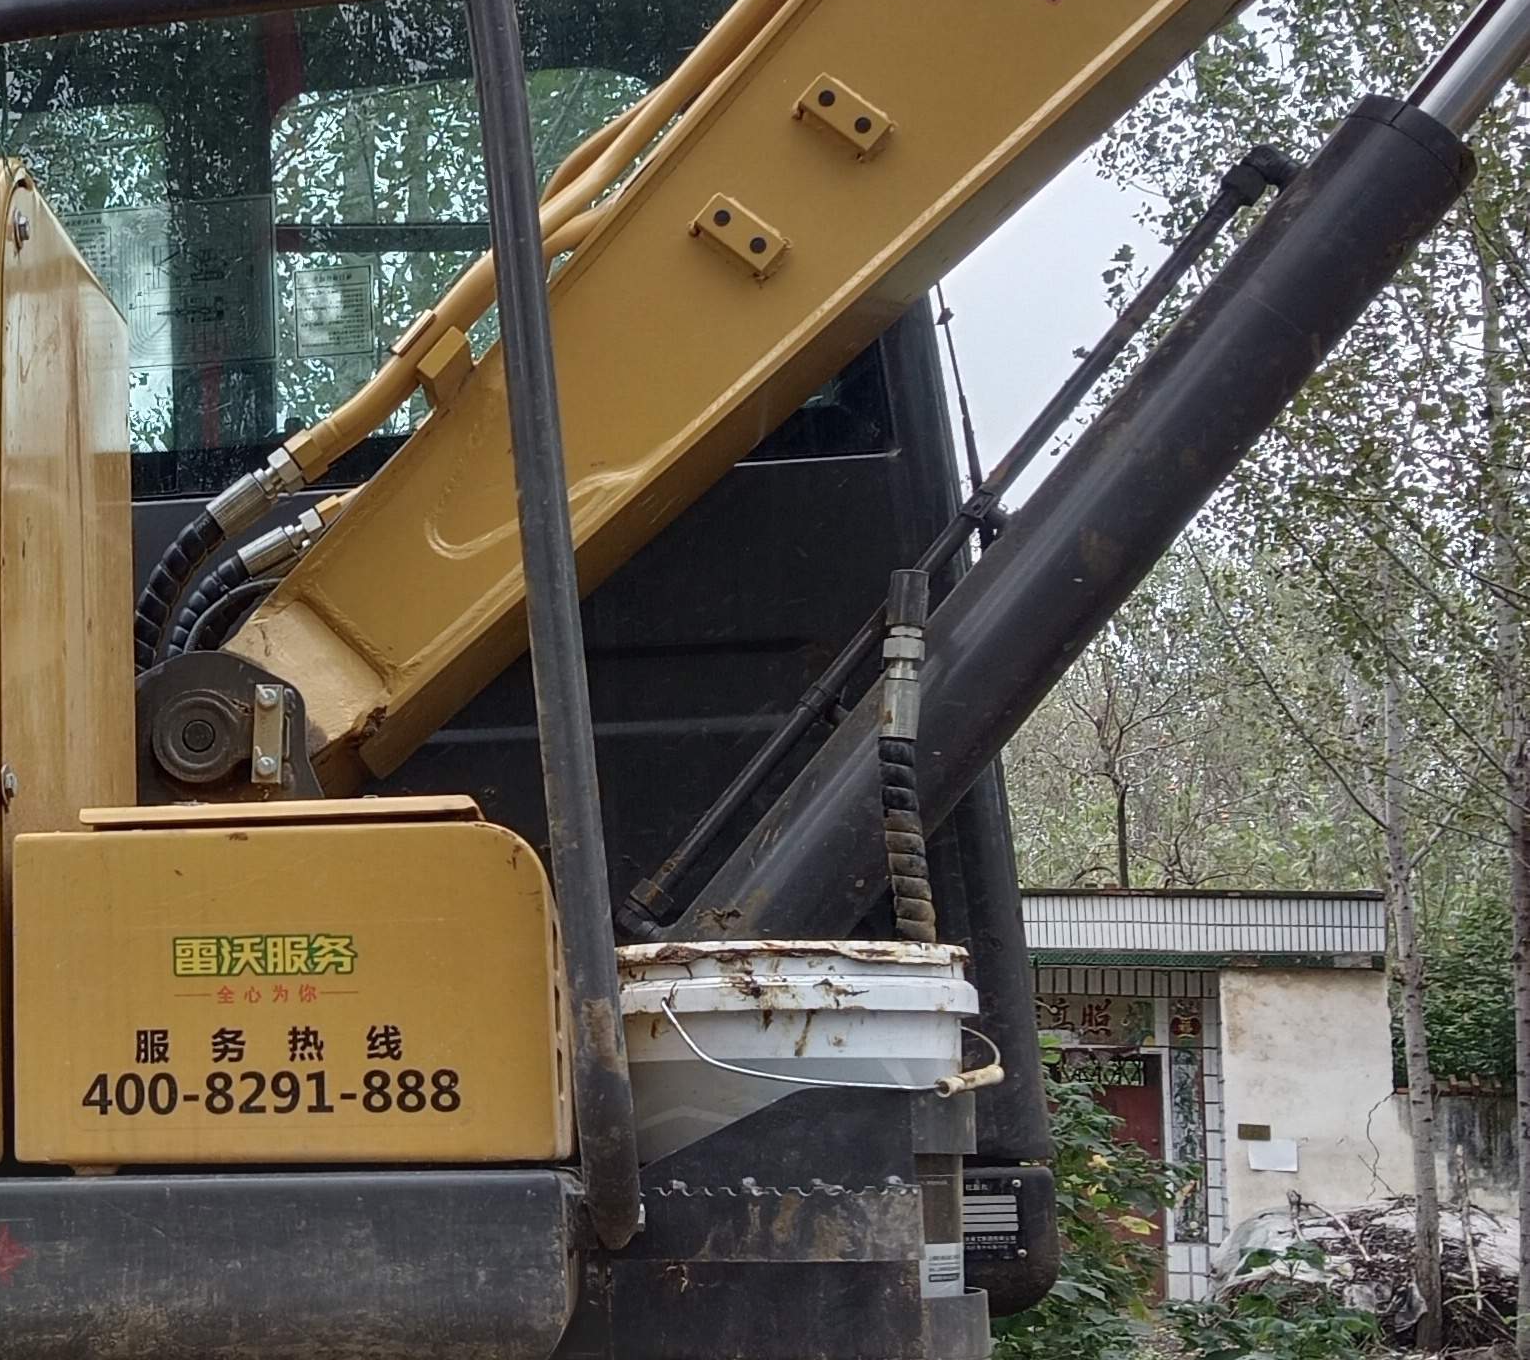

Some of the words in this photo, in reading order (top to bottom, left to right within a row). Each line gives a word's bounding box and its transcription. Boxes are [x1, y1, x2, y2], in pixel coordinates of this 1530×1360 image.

[173, 933, 358, 978] 雷沃服务
[217, 984, 318, 1005] 全心为你
[135, 1025, 403, 1065] 服务热线
[81, 1069, 462, 1116] 400-8291-888
